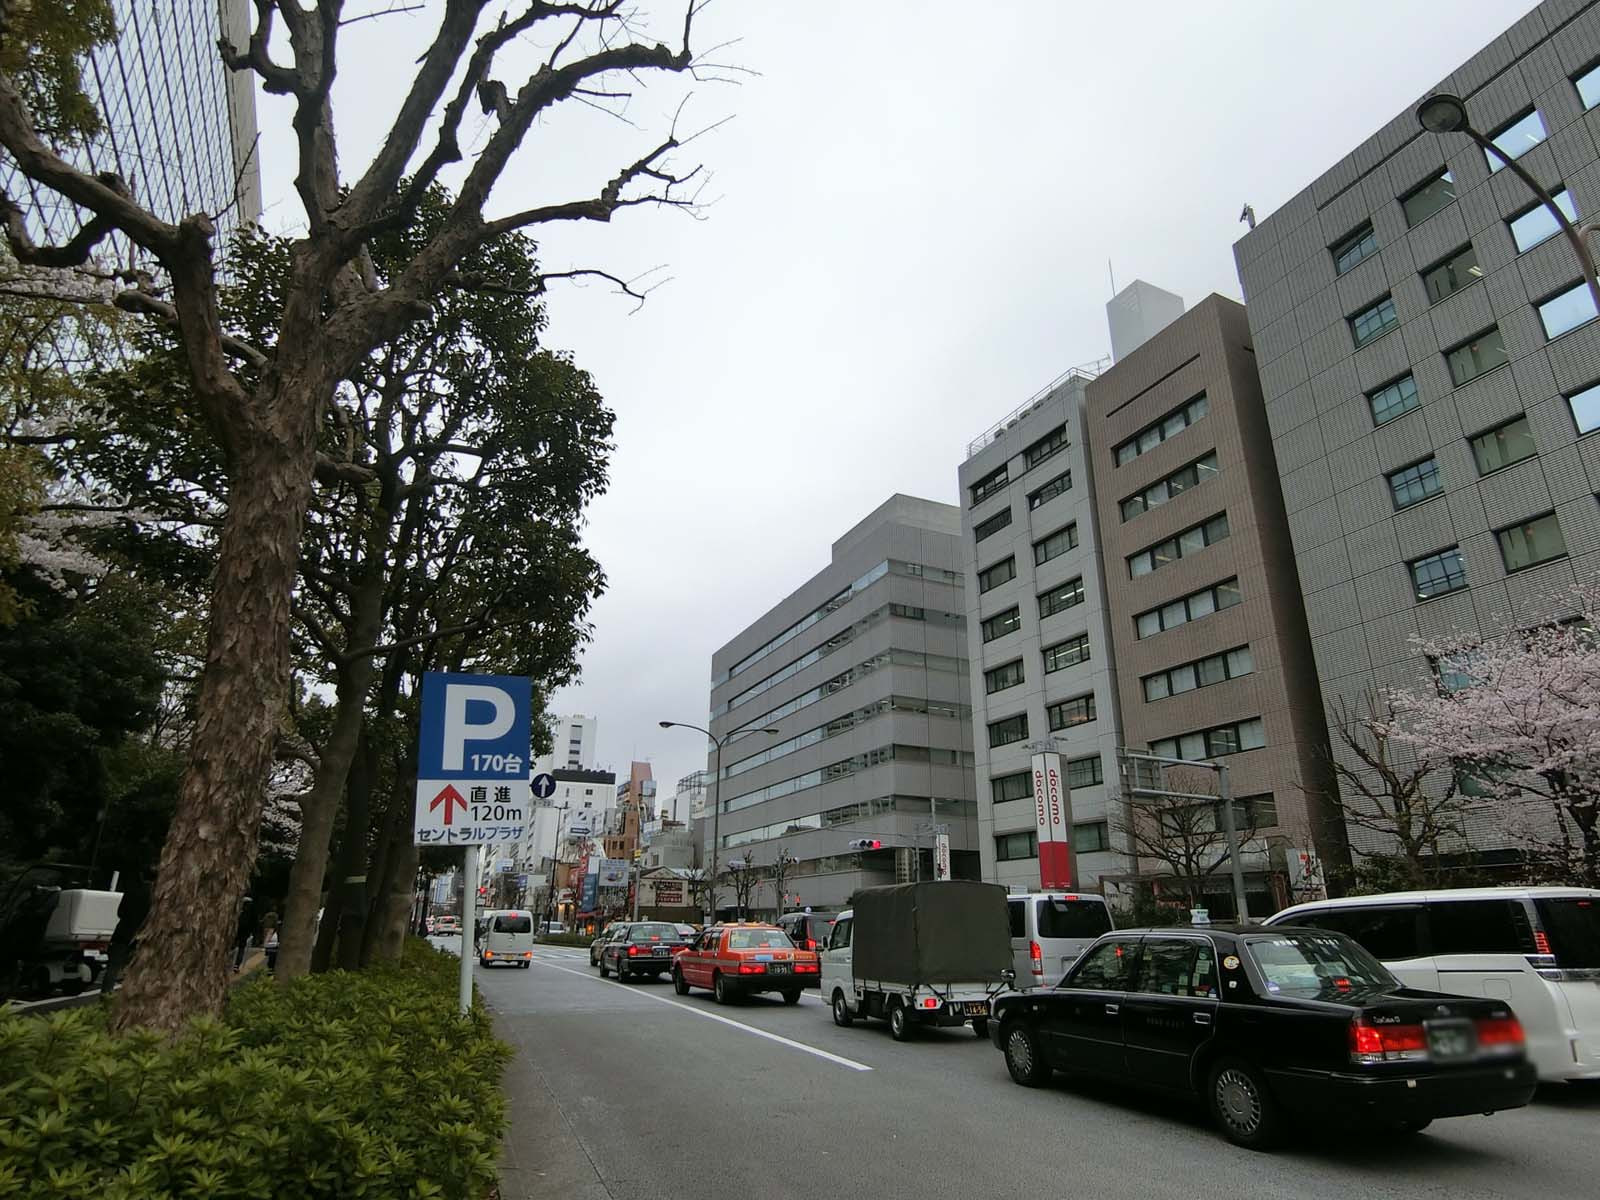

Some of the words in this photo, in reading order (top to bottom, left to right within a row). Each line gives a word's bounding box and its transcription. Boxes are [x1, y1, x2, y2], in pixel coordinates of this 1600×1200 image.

[442, 684, 516, 771] P
[471, 753, 523, 774] 170台
[470, 786, 512, 803] 直進
[1035, 770, 1045, 826] docomo
[1048, 769, 1060, 825] docomo
[471, 805, 522, 822] 120m
[417, 826, 525, 842] セントラルプラザ
